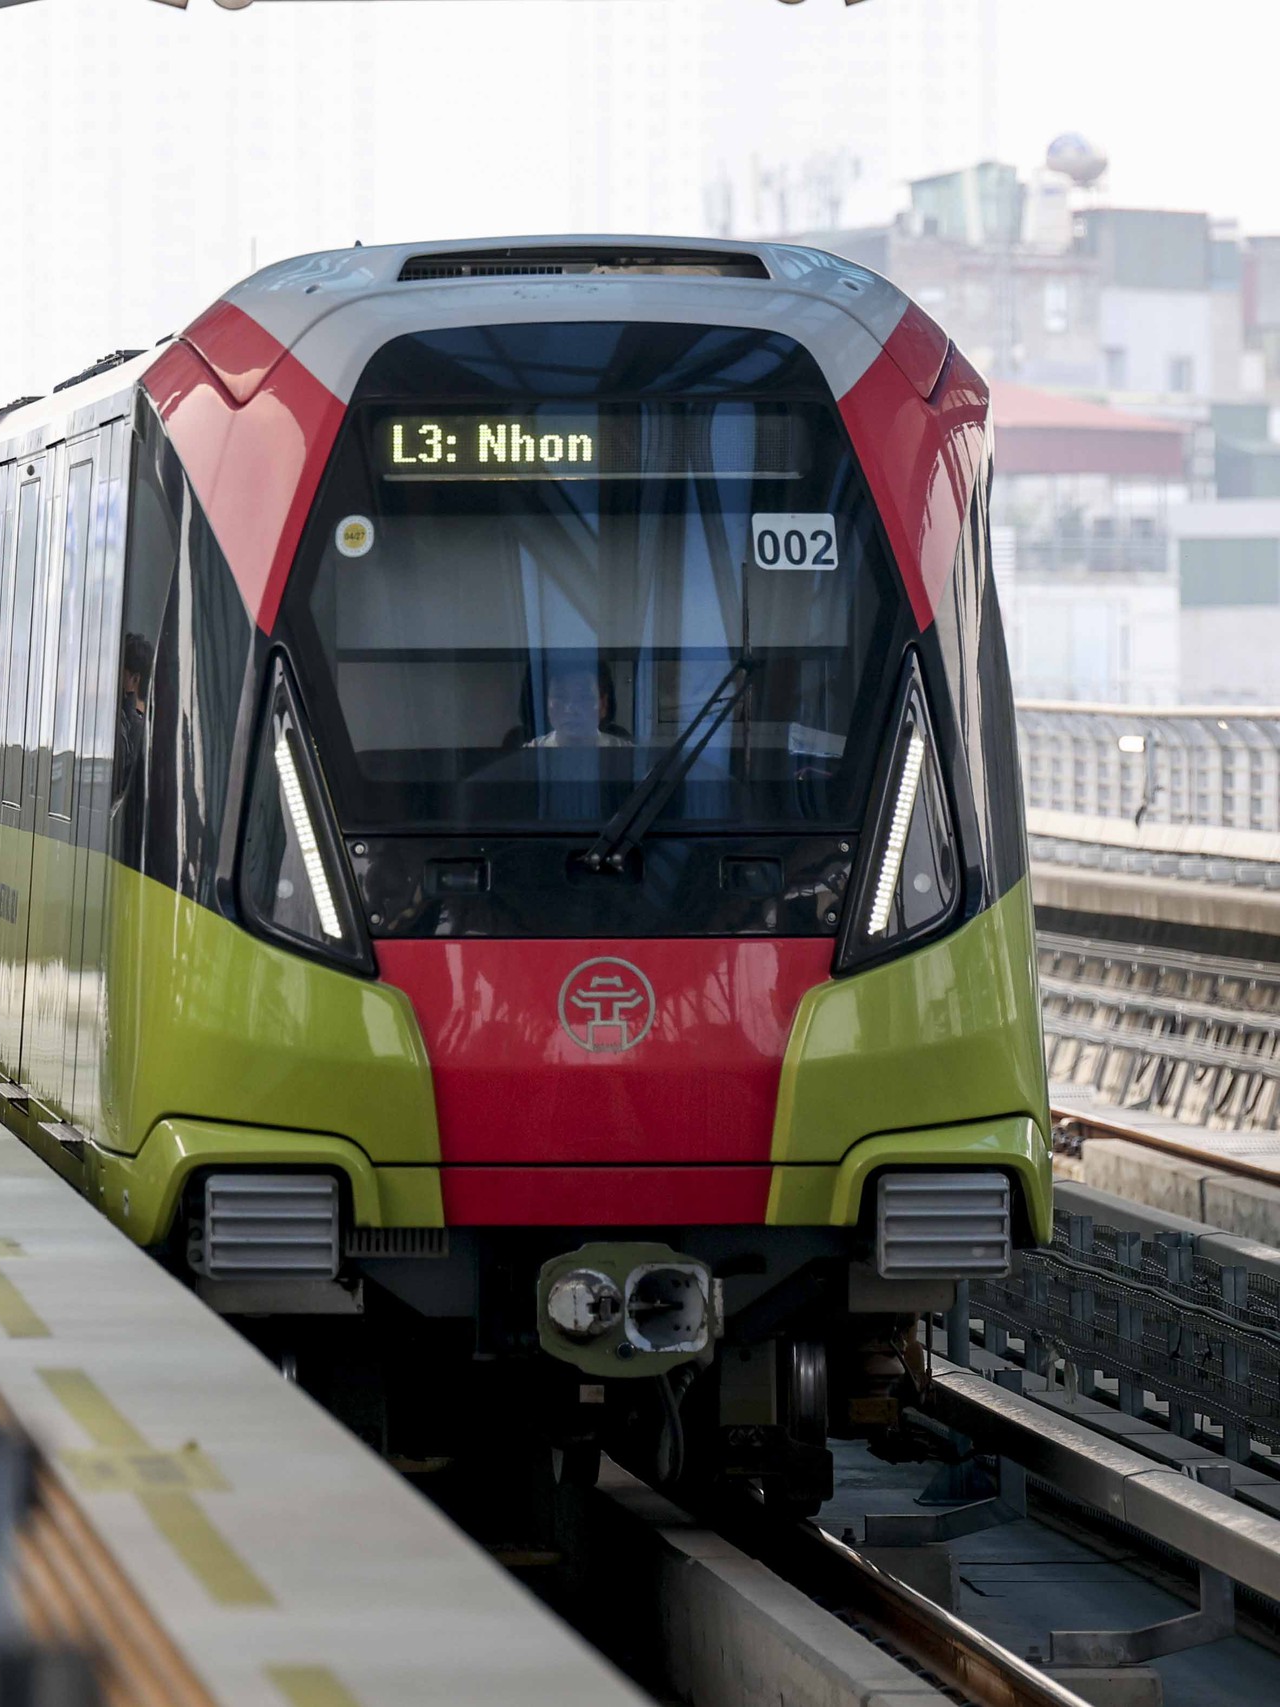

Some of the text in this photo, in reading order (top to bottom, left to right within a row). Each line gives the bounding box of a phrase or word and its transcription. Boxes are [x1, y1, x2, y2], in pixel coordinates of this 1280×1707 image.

[393, 424, 592, 463] L3: Nhon
[757, 529, 835, 566] 002
